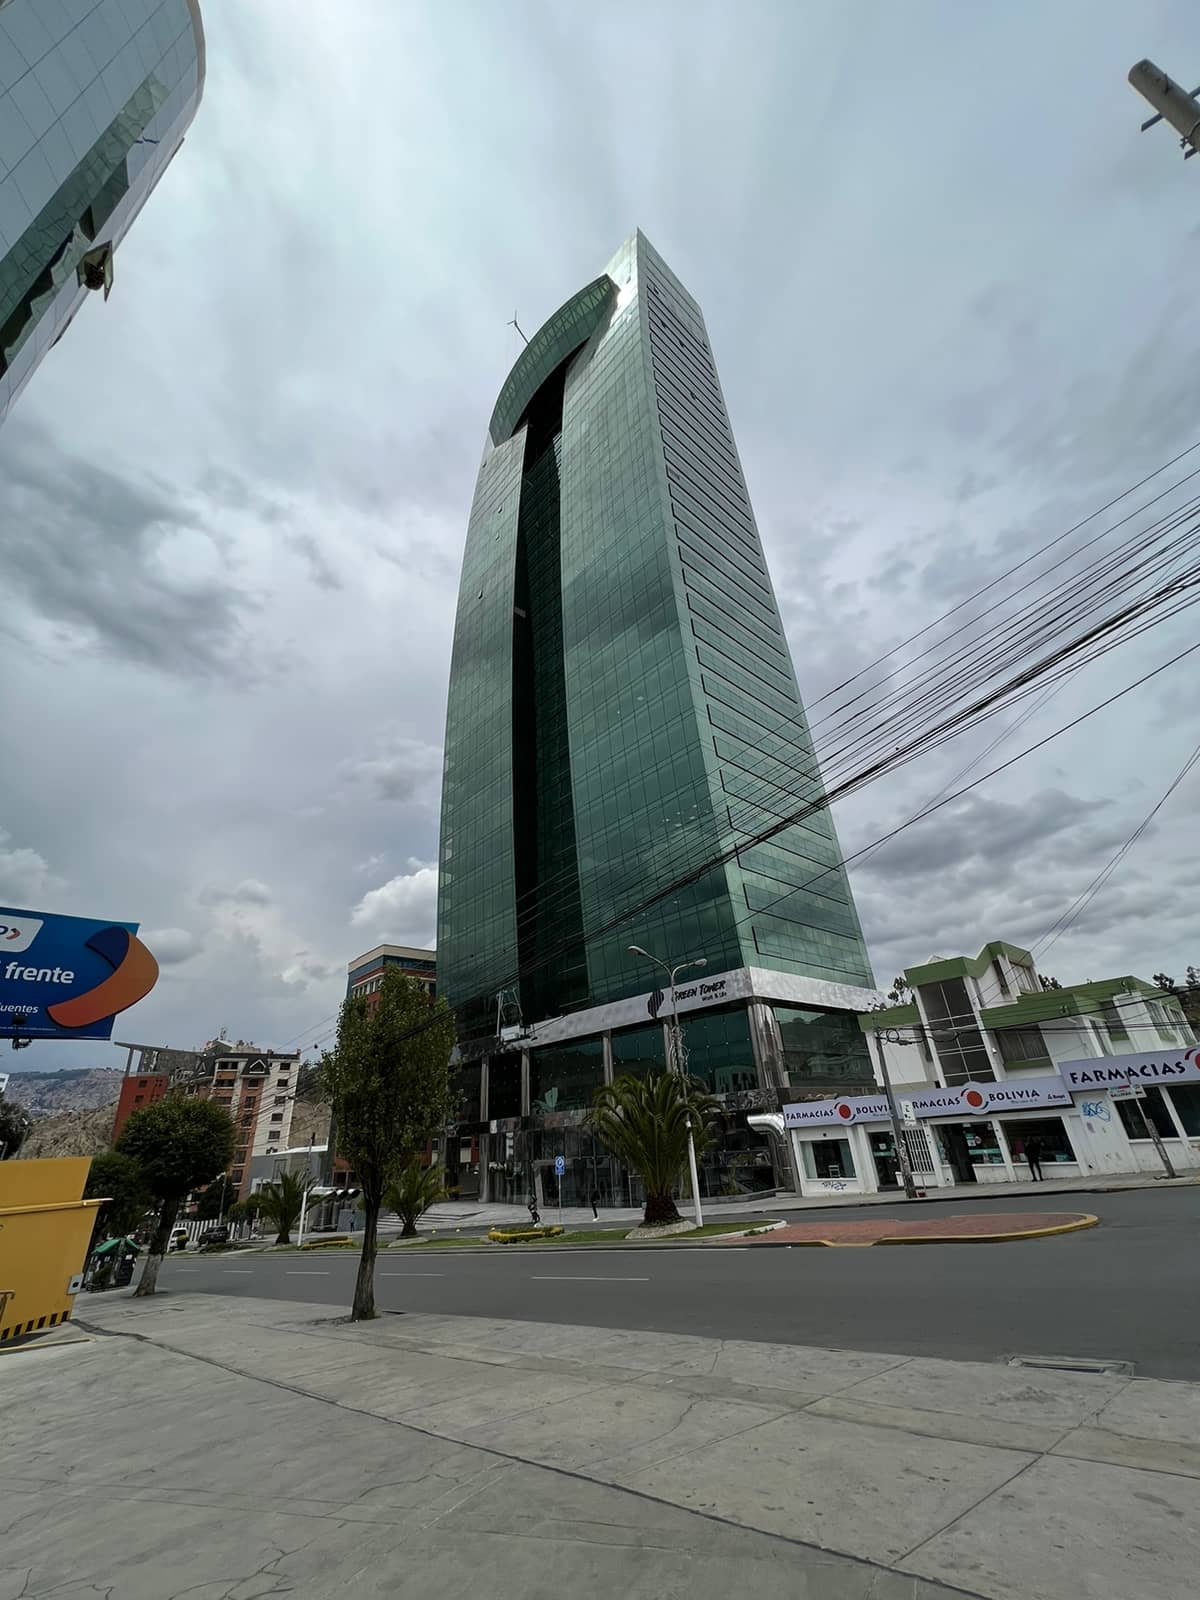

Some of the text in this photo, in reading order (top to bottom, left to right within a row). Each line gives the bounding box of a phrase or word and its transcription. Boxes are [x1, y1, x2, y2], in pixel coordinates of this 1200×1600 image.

[4, 961, 75, 984] frente
[0, 1002, 39, 1014] uentes
[1070, 1061, 1186, 1084] FARMACIAS
[911, 1096, 962, 1109] RMACIAS
[988, 1089, 1040, 1102] BOLIVIA
[785, 1109, 834, 1121] FARMACIAS
